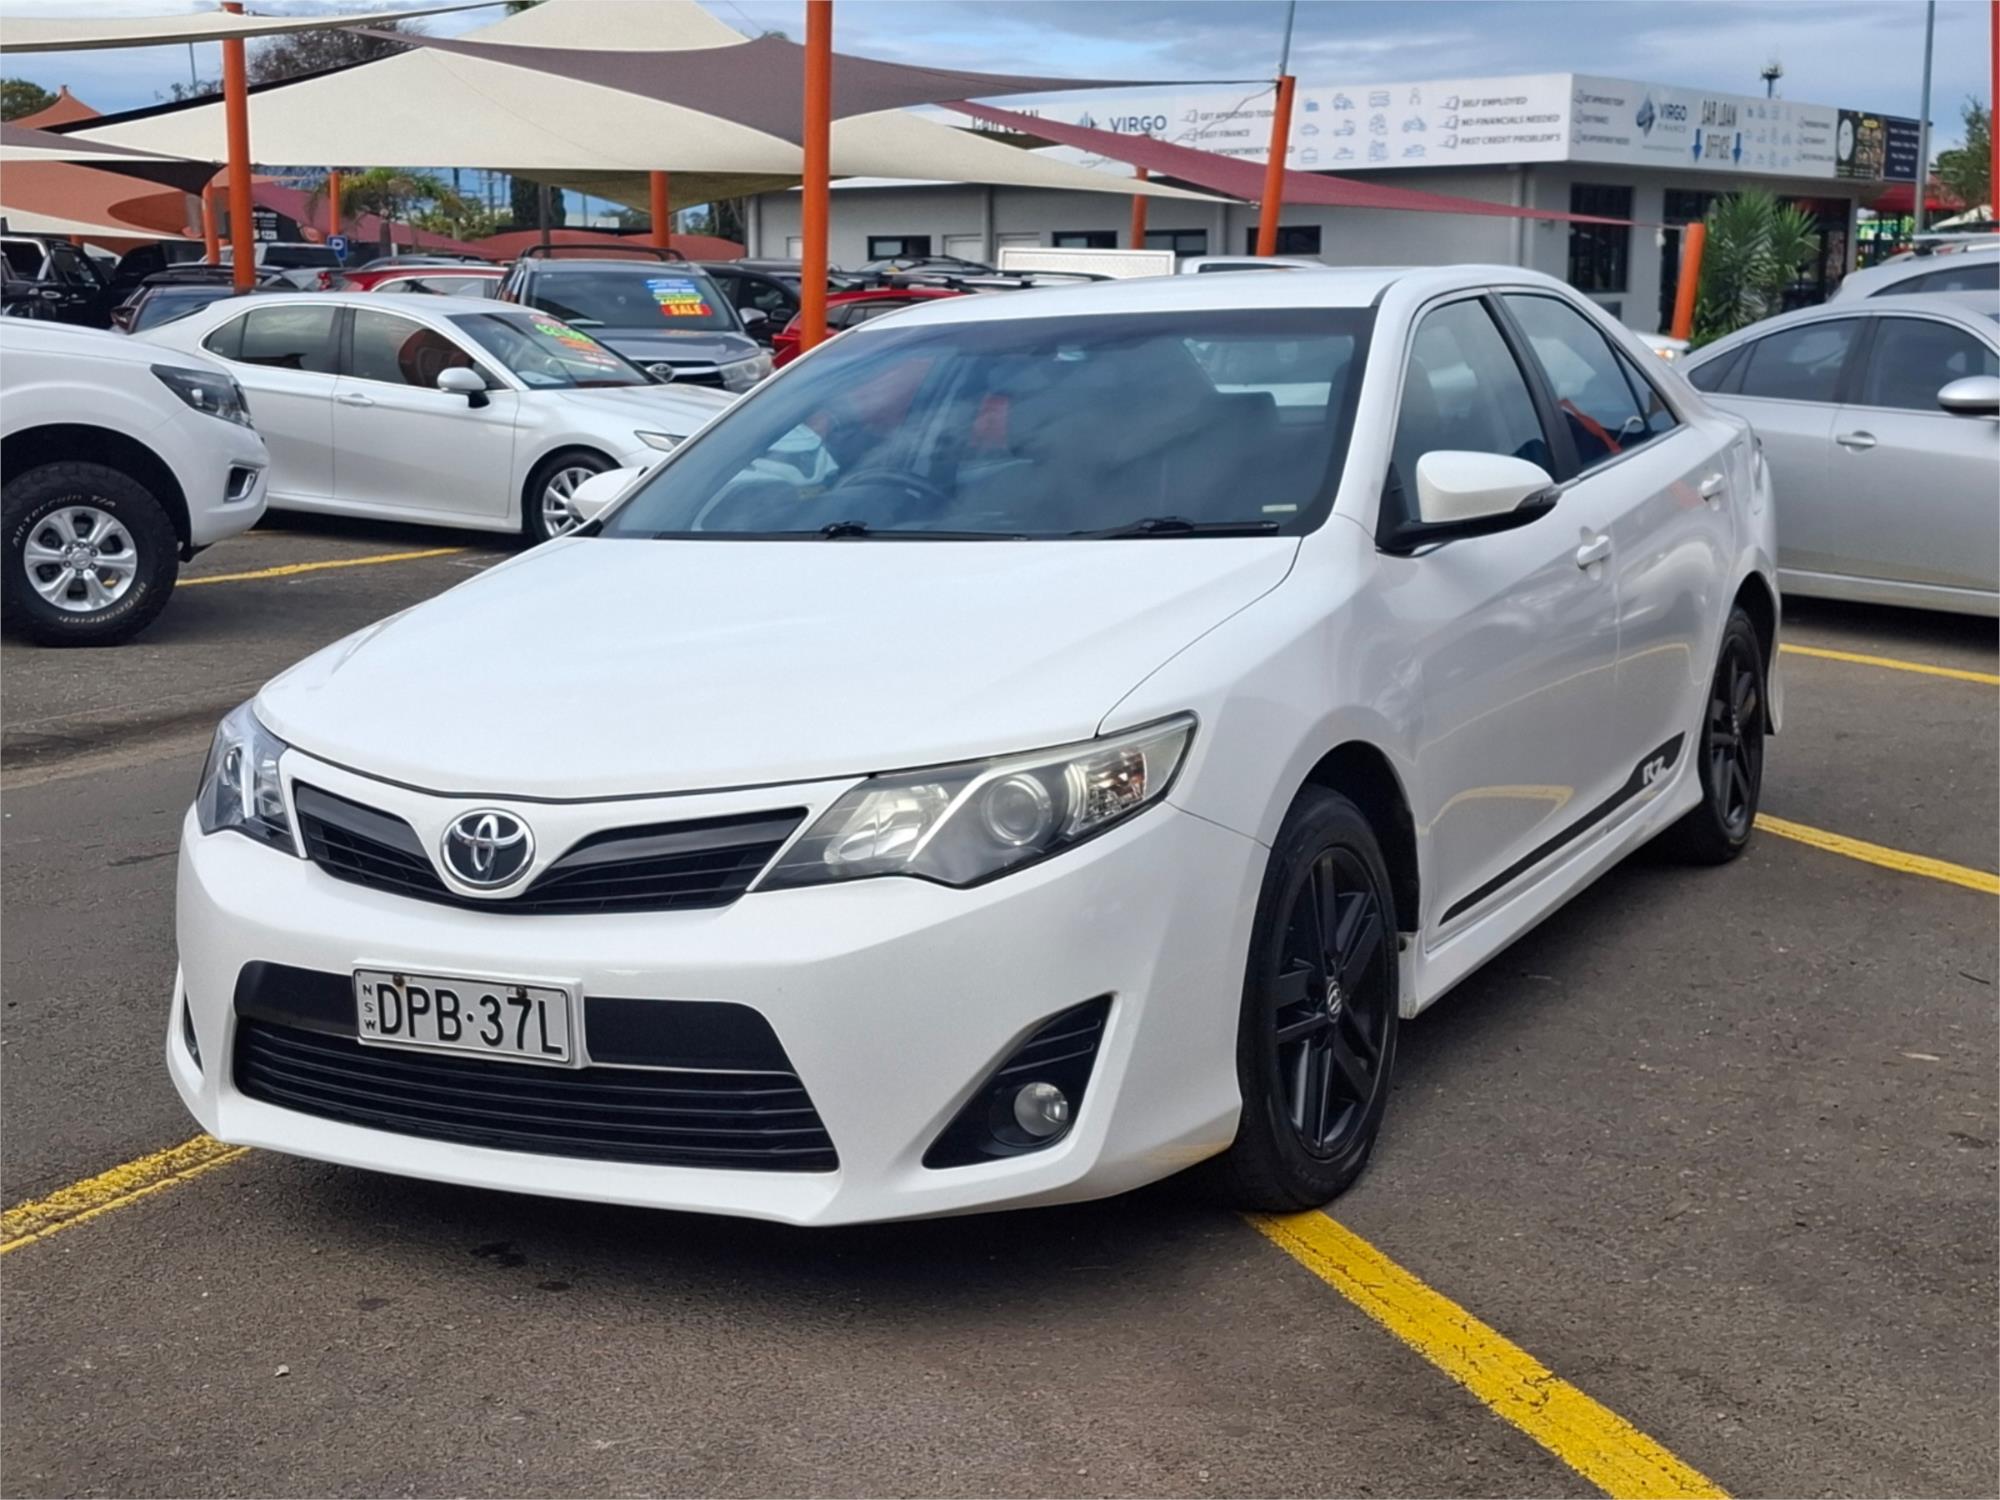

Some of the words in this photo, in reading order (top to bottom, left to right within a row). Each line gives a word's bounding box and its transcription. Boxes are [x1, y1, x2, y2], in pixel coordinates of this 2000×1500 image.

[1659, 103, 1688, 121] VIRGO
[1110, 114, 1167, 132] VIRGO
[670, 304, 704, 316] SALE
